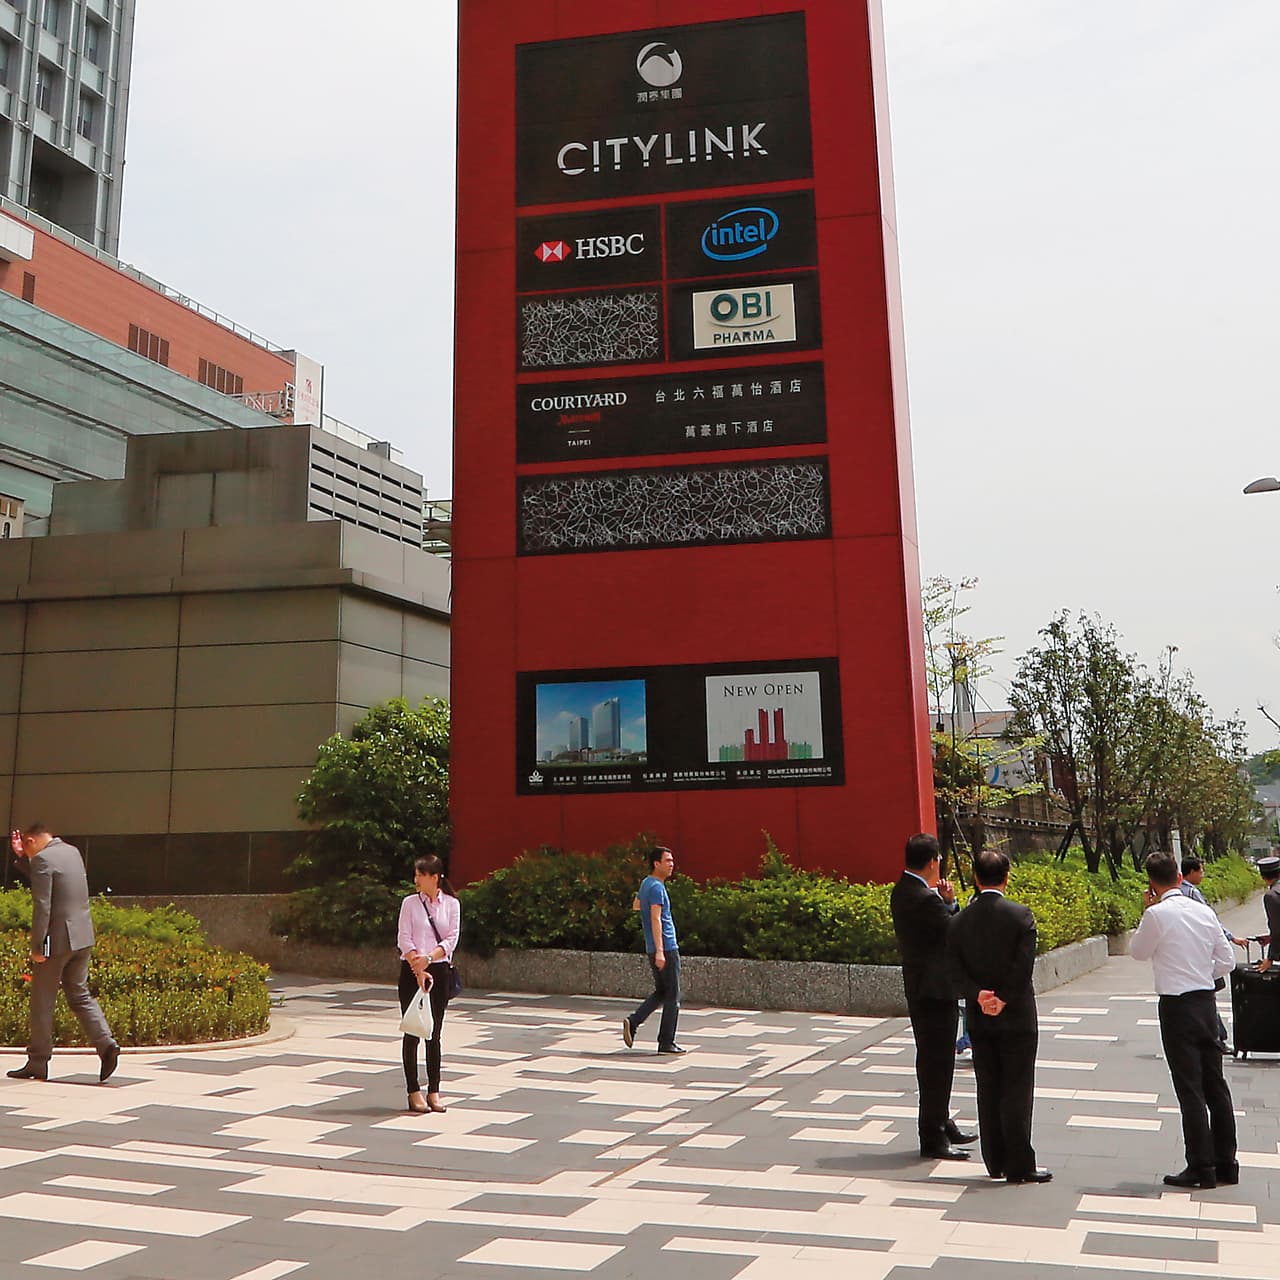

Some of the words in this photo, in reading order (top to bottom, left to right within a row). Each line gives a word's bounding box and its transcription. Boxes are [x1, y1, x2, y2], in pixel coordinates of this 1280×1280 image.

[556, 122, 769, 176] CITYLINK
[710, 218, 768, 246] intel
[575, 233, 645, 261] HSBC
[710, 291, 771, 322] OBI
[713, 328, 775, 345] PHARMA
[530, 391, 628, 413] COURTYARD
[655, 379, 802, 403] 台北六福萬怡酒店
[685, 419, 774, 439] 萬豪旗下酒店
[567, 439, 591, 447] TAIPEI
